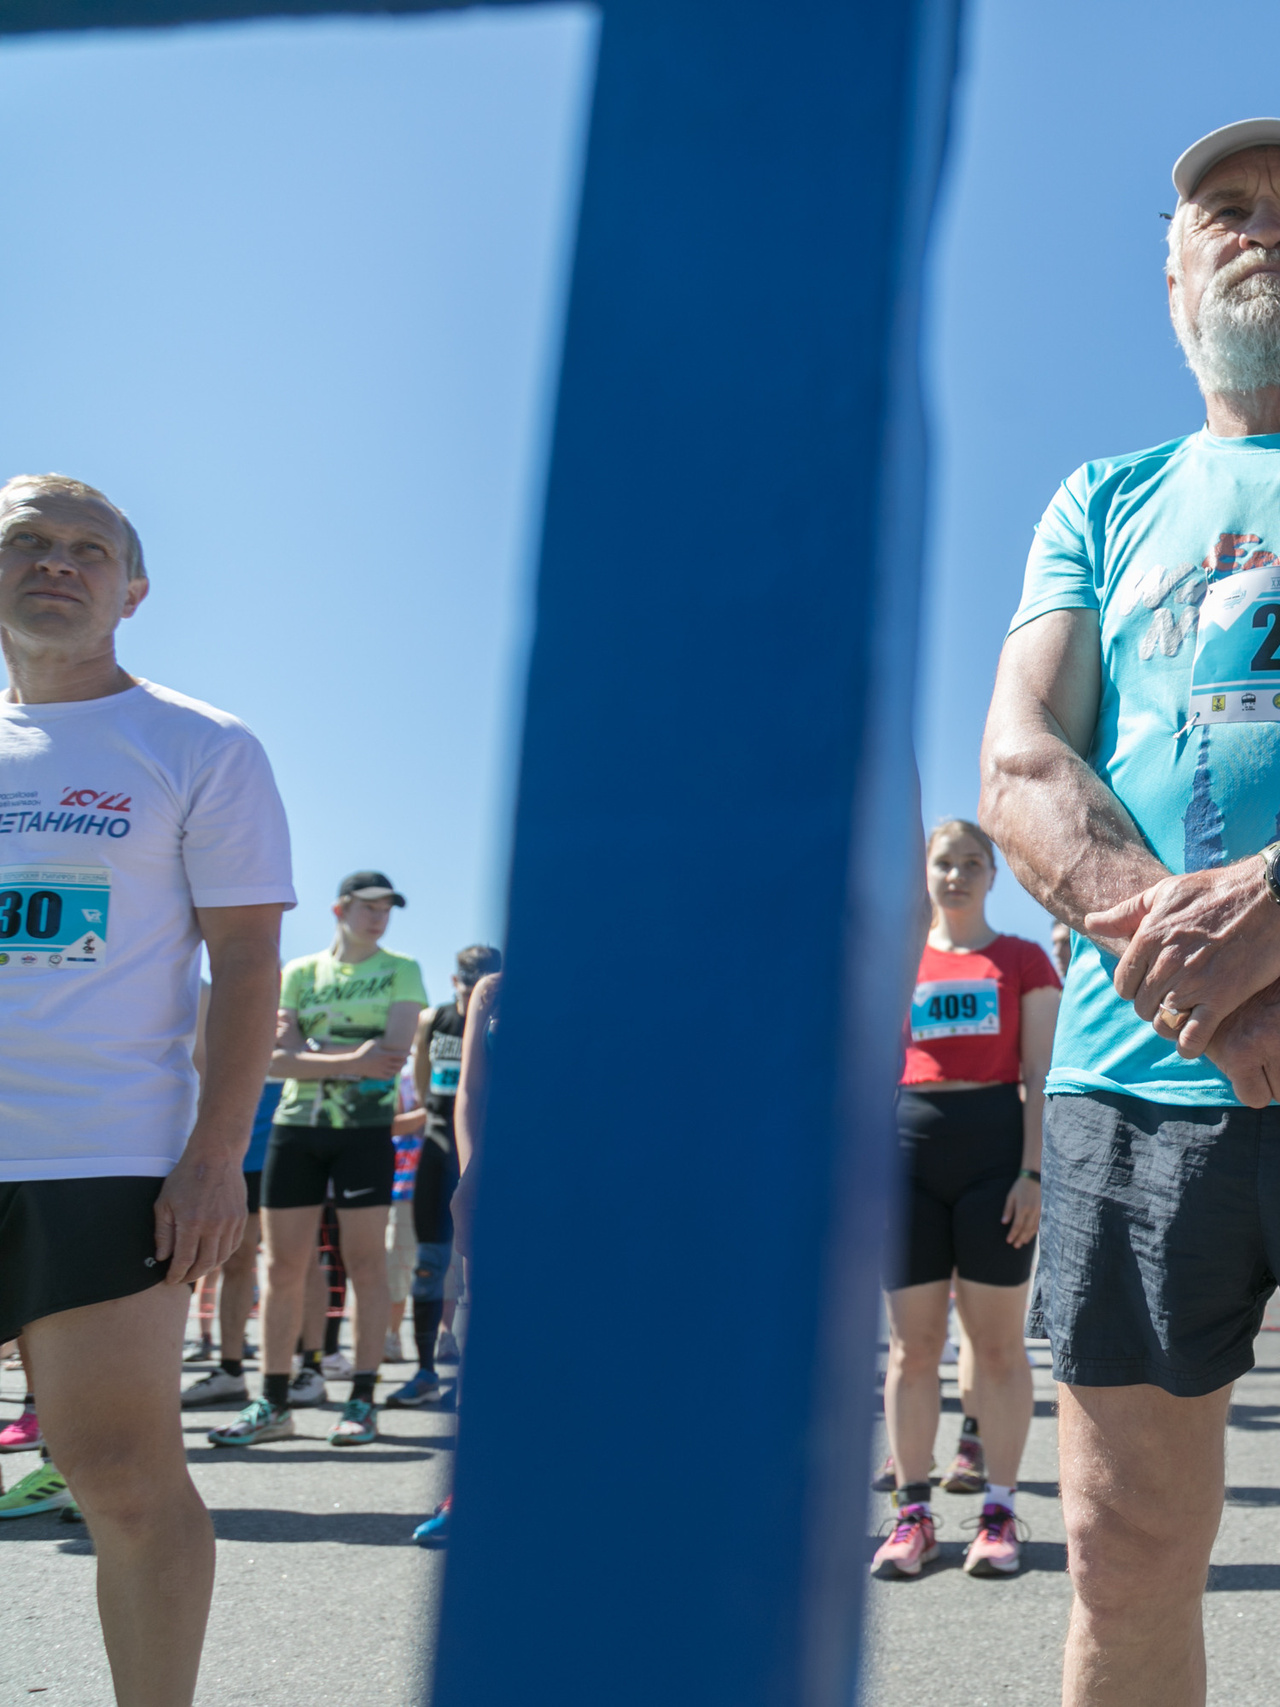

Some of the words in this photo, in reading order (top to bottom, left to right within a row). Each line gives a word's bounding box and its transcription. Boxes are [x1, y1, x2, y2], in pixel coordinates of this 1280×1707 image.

[59, 786, 132, 813] 2022
[0, 811, 131, 839] ЕТАНИНО
[928, 993, 978, 1021] 409
